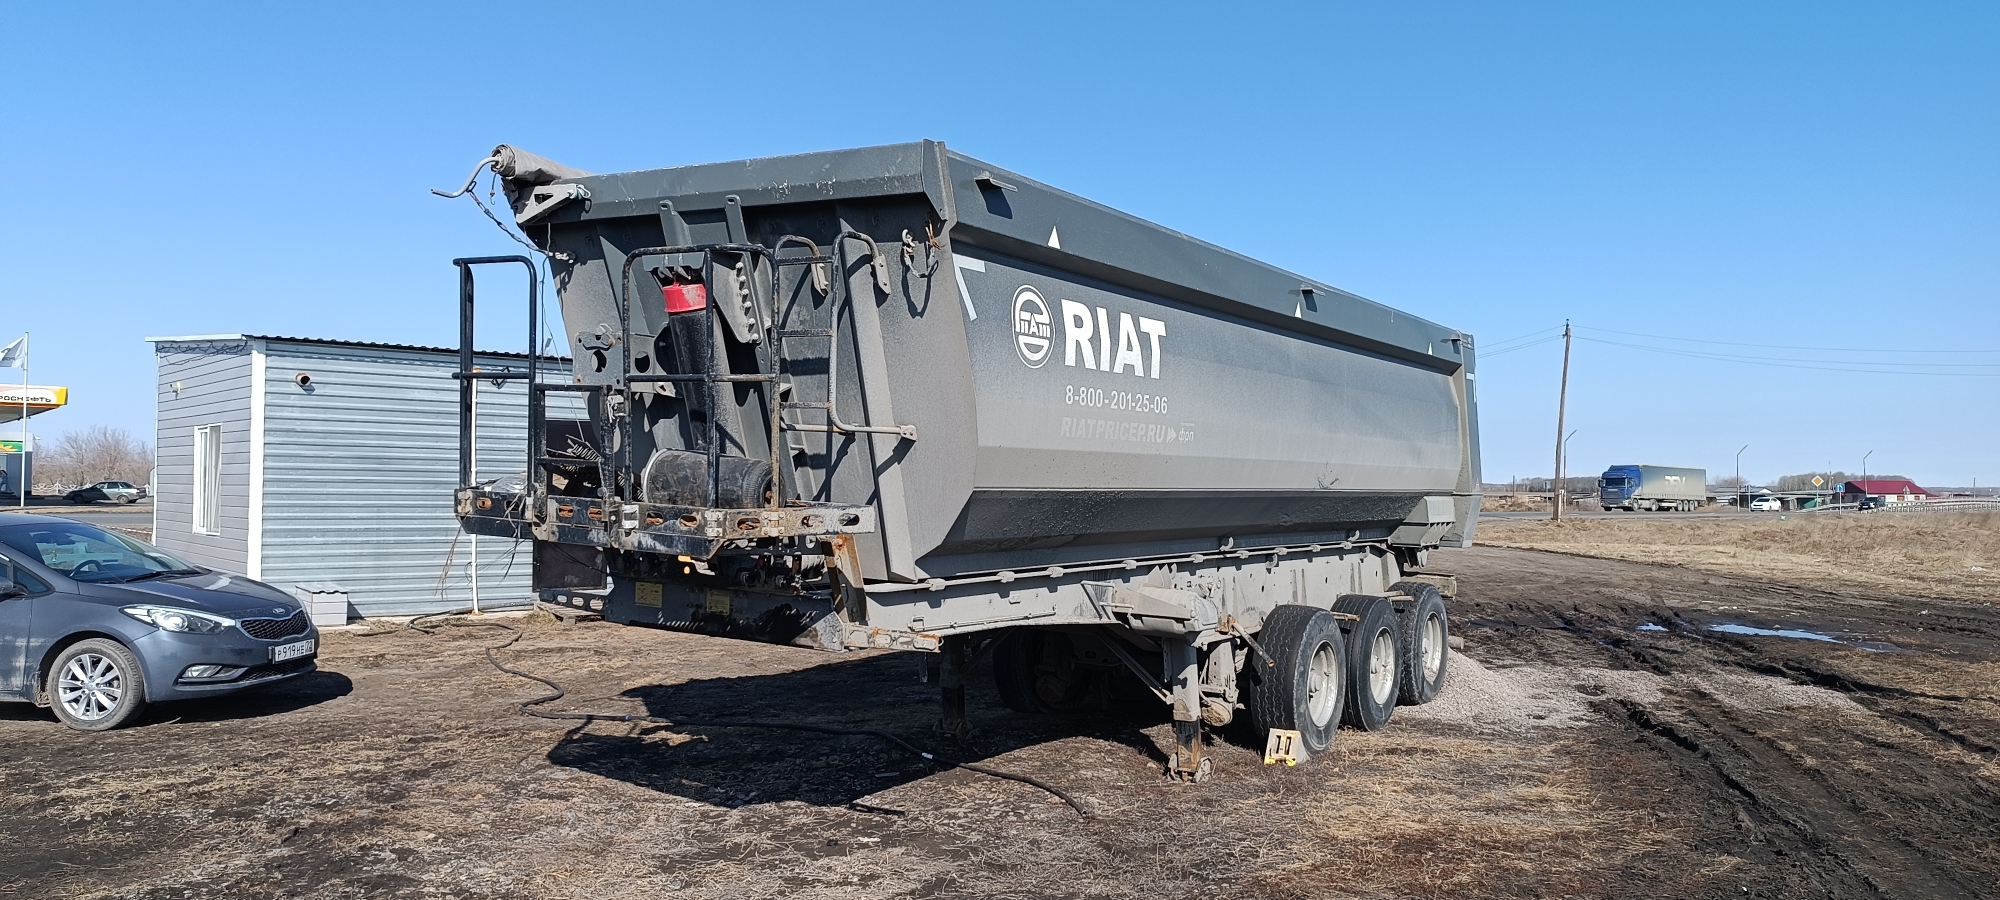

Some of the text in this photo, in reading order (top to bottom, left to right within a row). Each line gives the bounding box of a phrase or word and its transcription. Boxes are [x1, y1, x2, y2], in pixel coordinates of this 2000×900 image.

[1060, 298, 1167, 379] RIAT
[1065, 385, 1168, 414] 8-800-201-25-06
[1060, 416, 1165, 443] RIATPRICEP.RU
